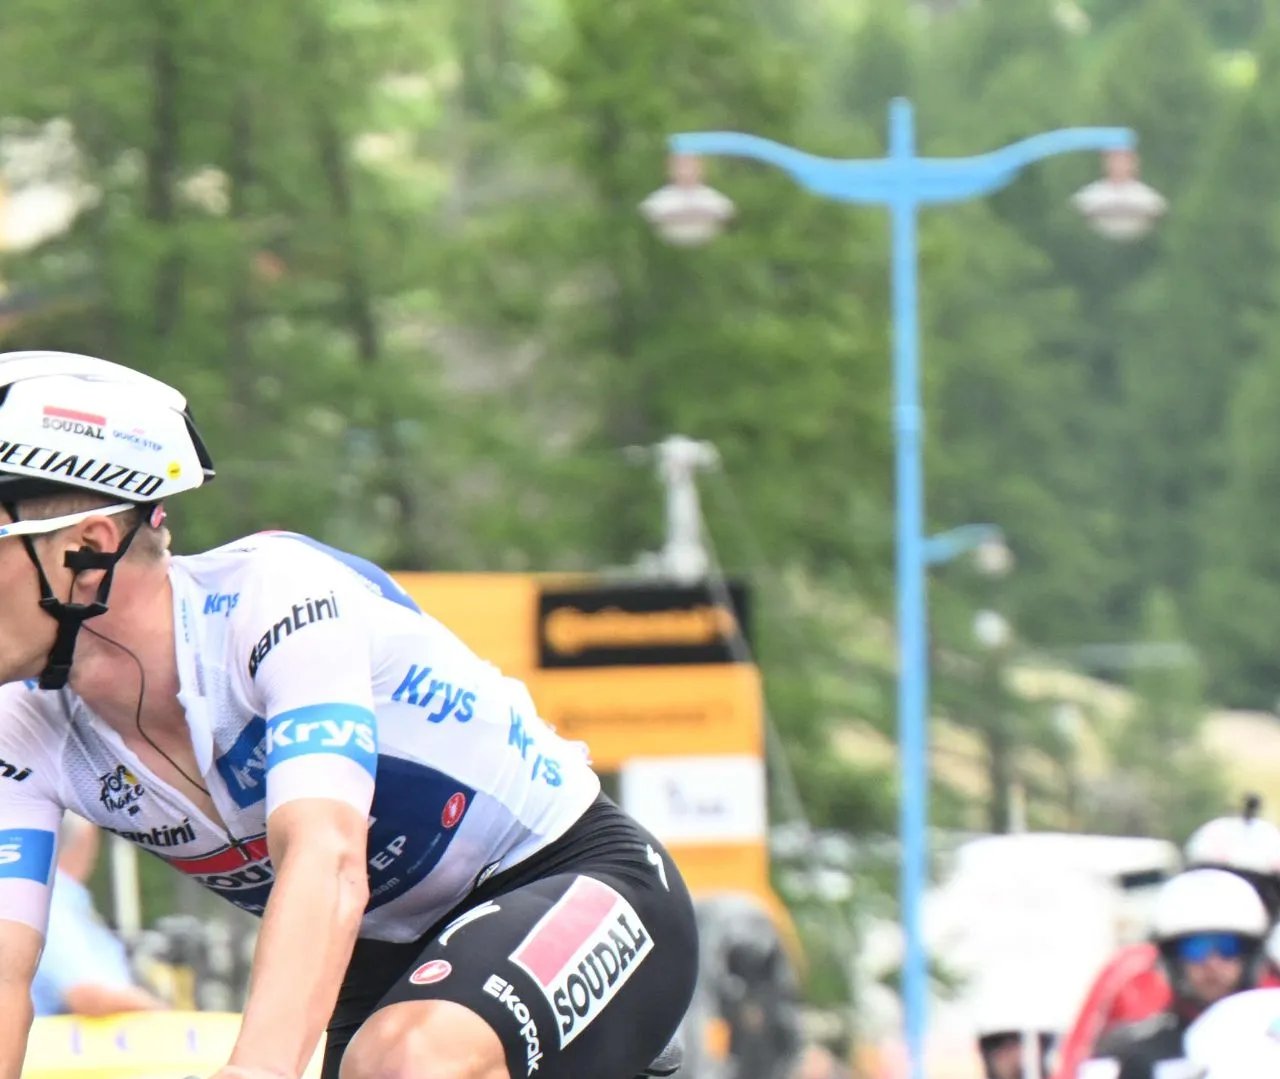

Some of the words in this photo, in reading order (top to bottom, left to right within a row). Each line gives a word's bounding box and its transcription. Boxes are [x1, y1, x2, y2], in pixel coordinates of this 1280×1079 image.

[42, 416, 105, 440] SOUDAL
[203, 592, 240, 618] Krys
[391, 664, 478, 724] Krys
[268, 718, 377, 755] Krys
[101, 815, 197, 847] antini
[552, 912, 646, 1042] SOUDAL
